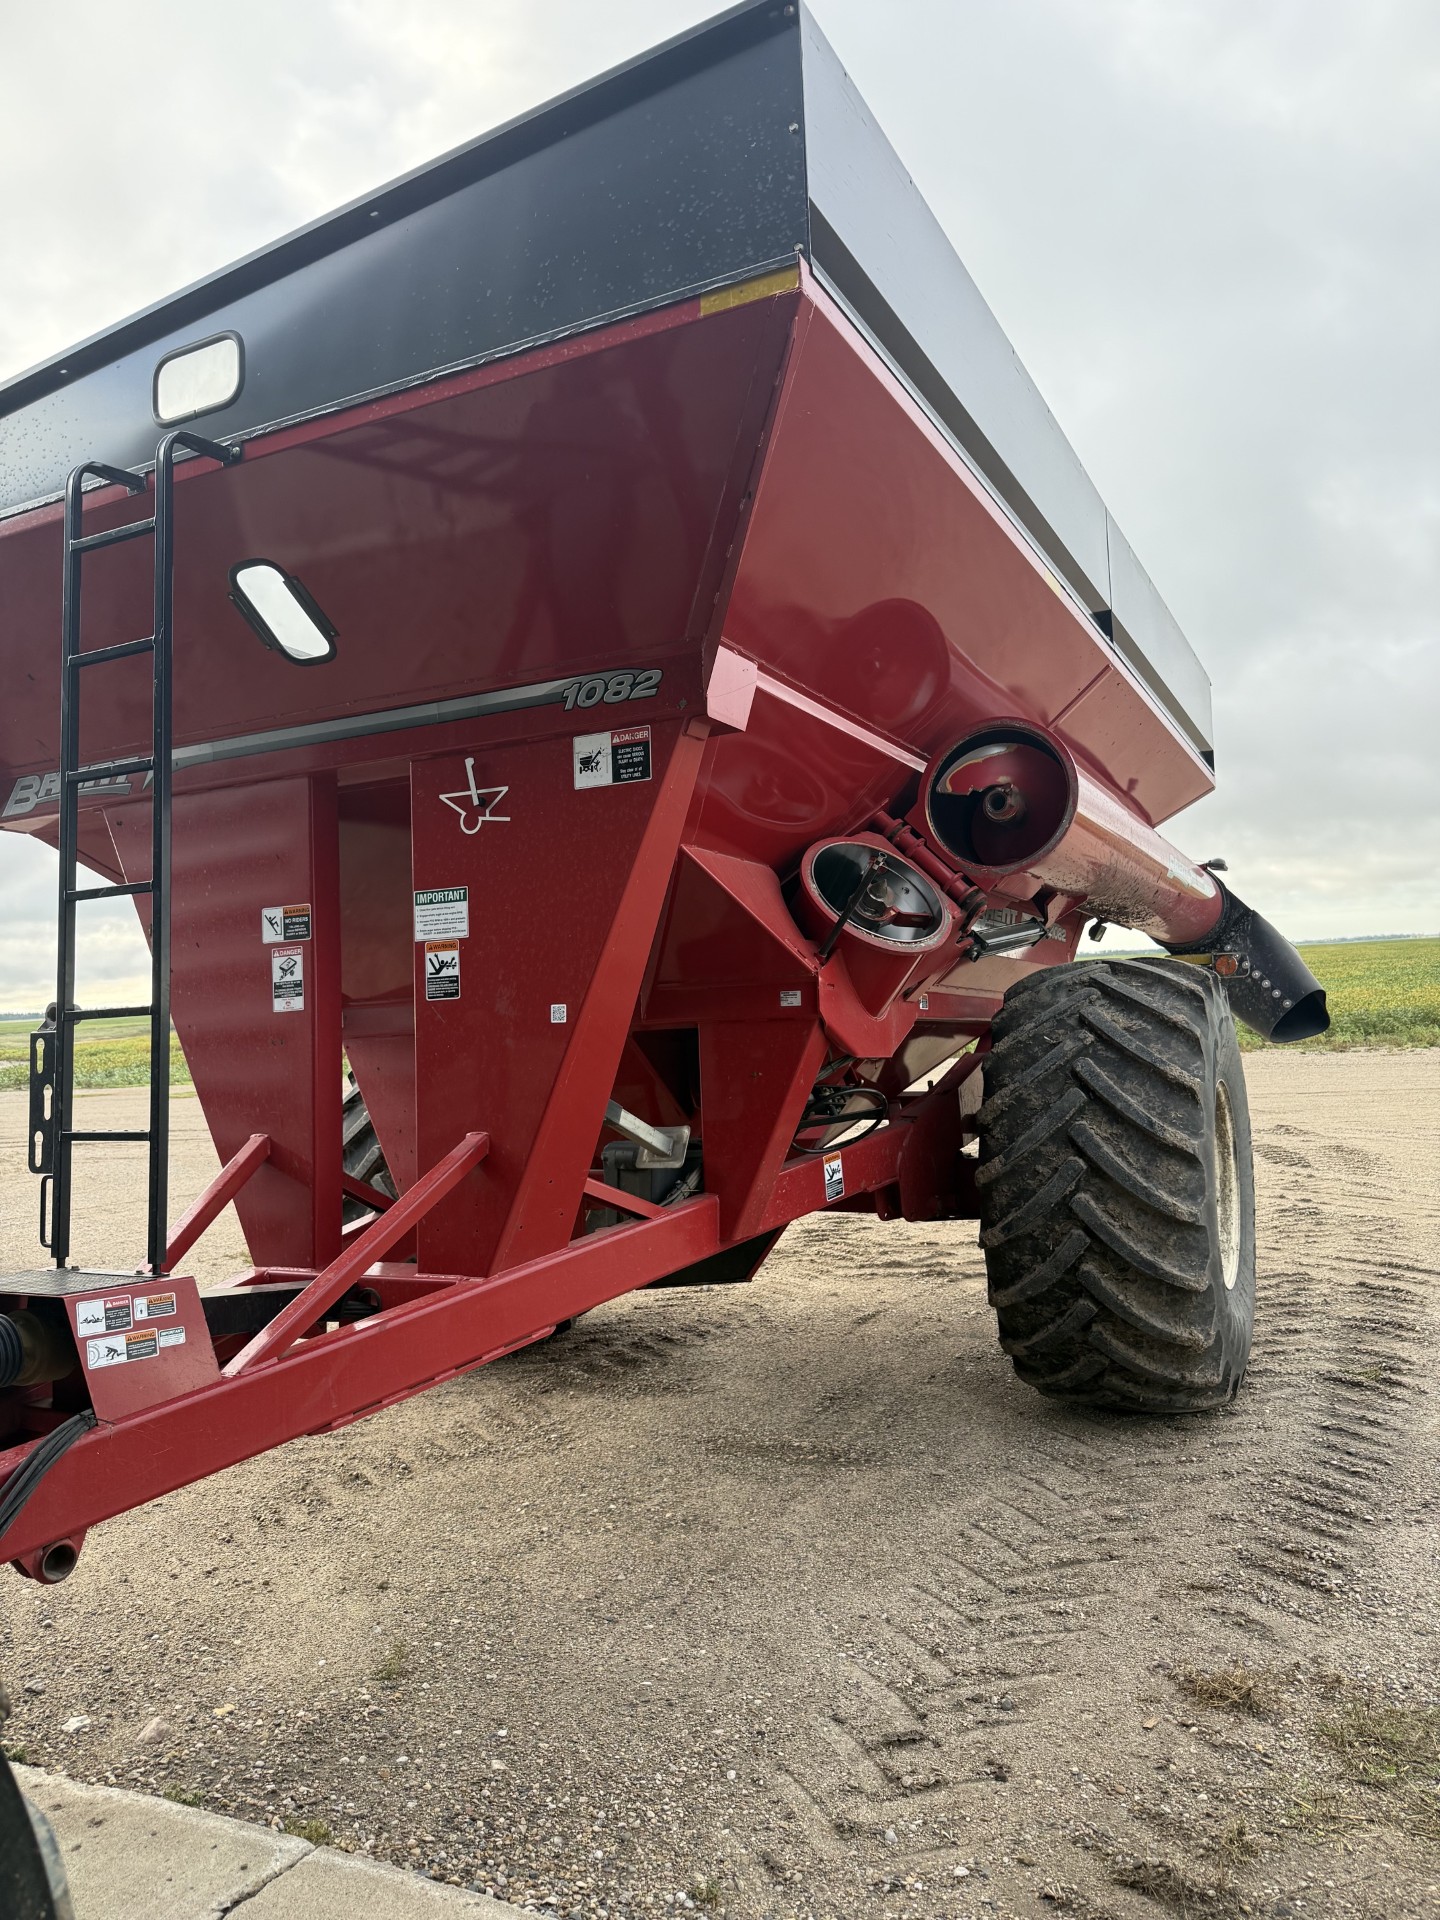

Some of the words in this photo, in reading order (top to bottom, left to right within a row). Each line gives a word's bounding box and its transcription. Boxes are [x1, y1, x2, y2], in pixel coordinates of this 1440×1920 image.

[563, 670, 663, 711] 1082
[620, 731, 649, 742] DANGER
[417, 890, 465, 904] IMPORTANT
[433, 942, 457, 950] WARNING
[132, 1331, 155, 1341] WARNING
